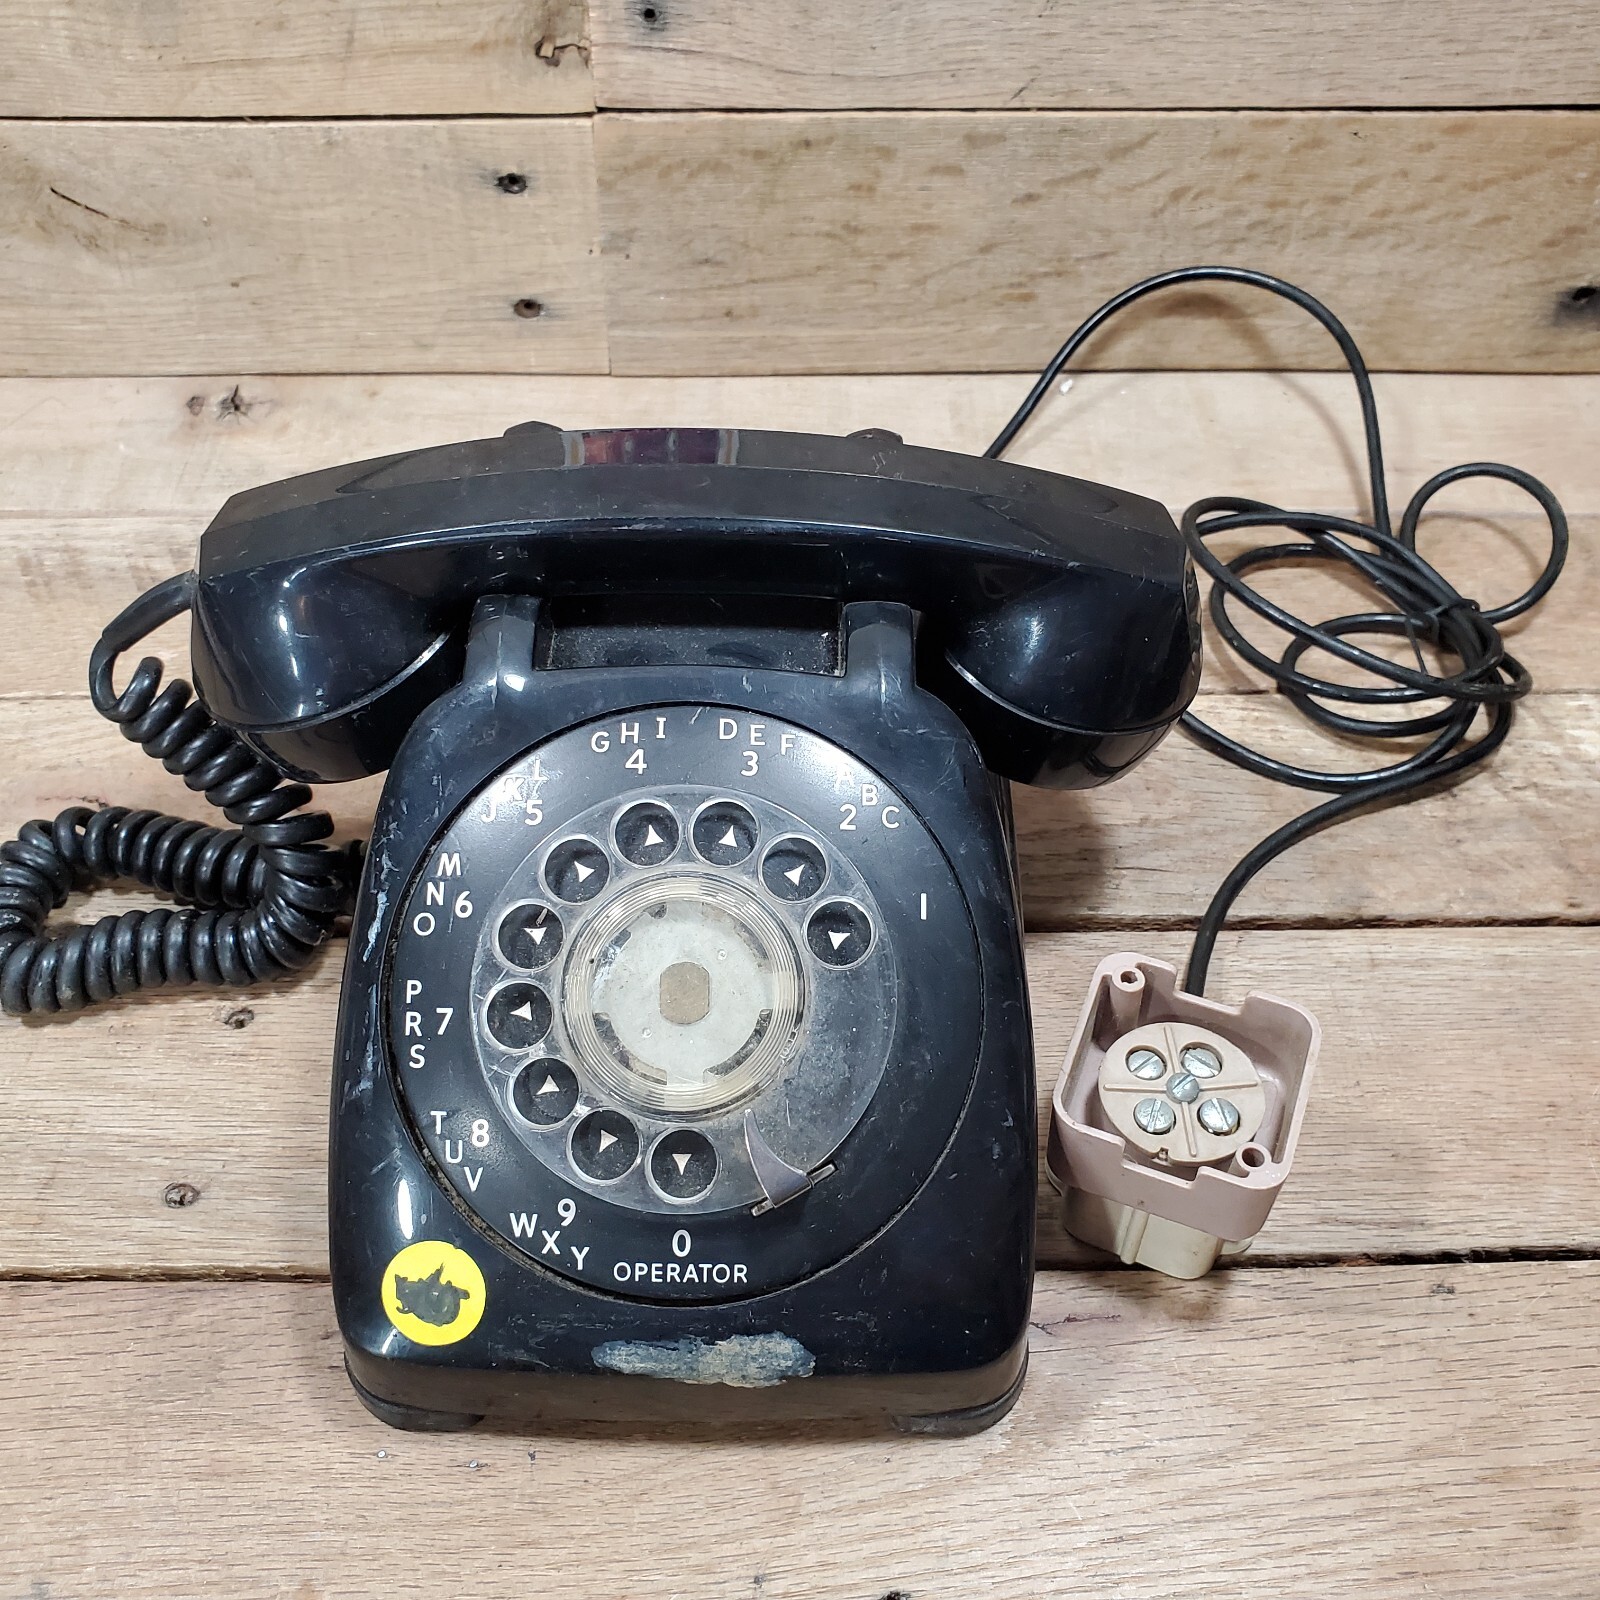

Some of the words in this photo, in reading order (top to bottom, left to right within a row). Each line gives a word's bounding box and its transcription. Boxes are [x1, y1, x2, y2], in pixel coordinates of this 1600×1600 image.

[624, 748, 648, 775] 4
[740, 750, 760, 777] 3
[524, 799, 543, 826] 5
[839, 802, 857, 831] 2
[454, 890, 473, 919] 6
[436, 1007, 454, 1036] 7
[470, 1118, 490, 1148] 8
[557, 1198, 577, 1227] 9
[613, 1261, 748, 1284] OPERATOR
